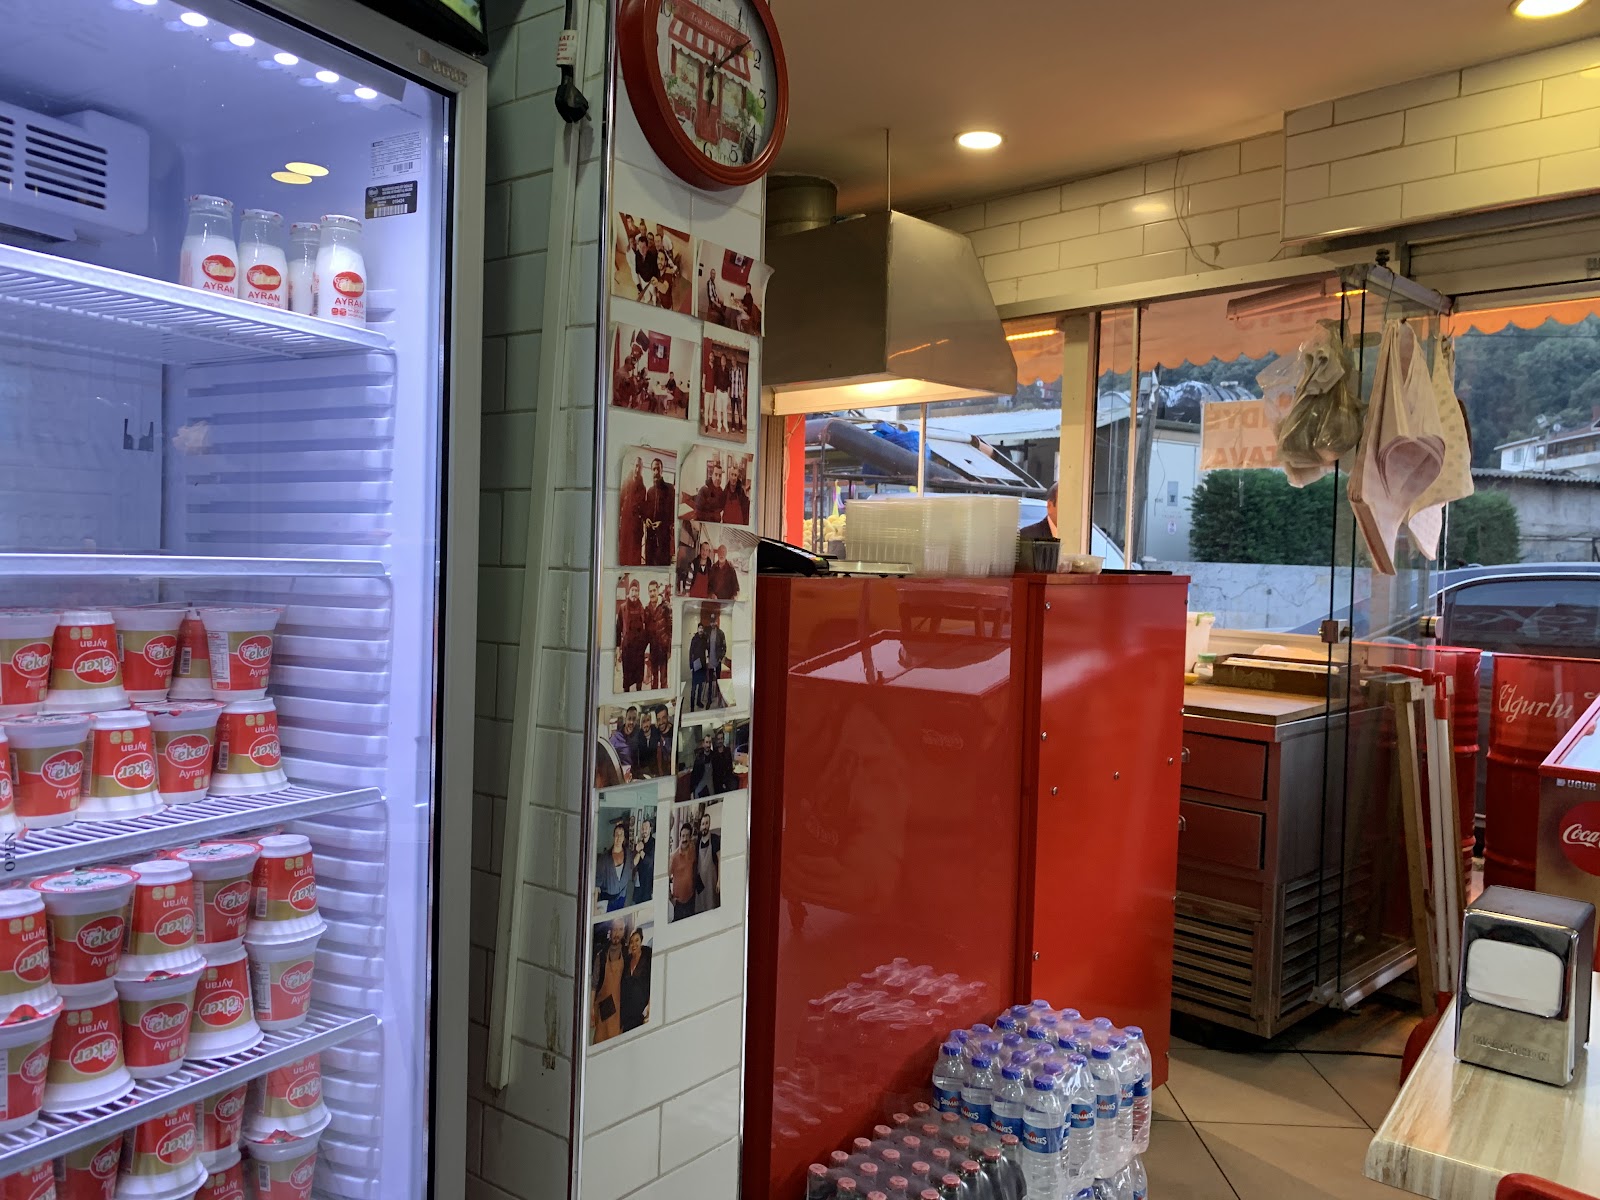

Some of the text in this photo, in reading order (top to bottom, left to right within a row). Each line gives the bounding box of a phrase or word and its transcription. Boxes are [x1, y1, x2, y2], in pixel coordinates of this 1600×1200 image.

[203, 281, 235, 295] AYRAN
[248, 290, 280, 302] AYRAN
[80, 639, 108, 648] Ayran
[247, 644, 272, 661] eker
[77, 656, 113, 673] eker
[121, 741, 147, 752] Ayran
[177, 743, 209, 762] eker
[118, 760, 153, 779] eker
[179, 768, 205, 779] Ayran
[163, 896, 189, 908] Ayran
[159, 914, 194, 936] eker
[89, 924, 124, 948] eker
[205, 978, 233, 989] Ayran
[201, 996, 240, 1016] eker
[78, 1020, 109, 1034] Ayran
[153, 1009, 187, 1033] eker
[74, 1039, 114, 1064] eker
[154, 1037, 182, 1051] Ayran
[164, 1112, 191, 1127] Ayran
[213, 1180, 238, 1195] Ayran
